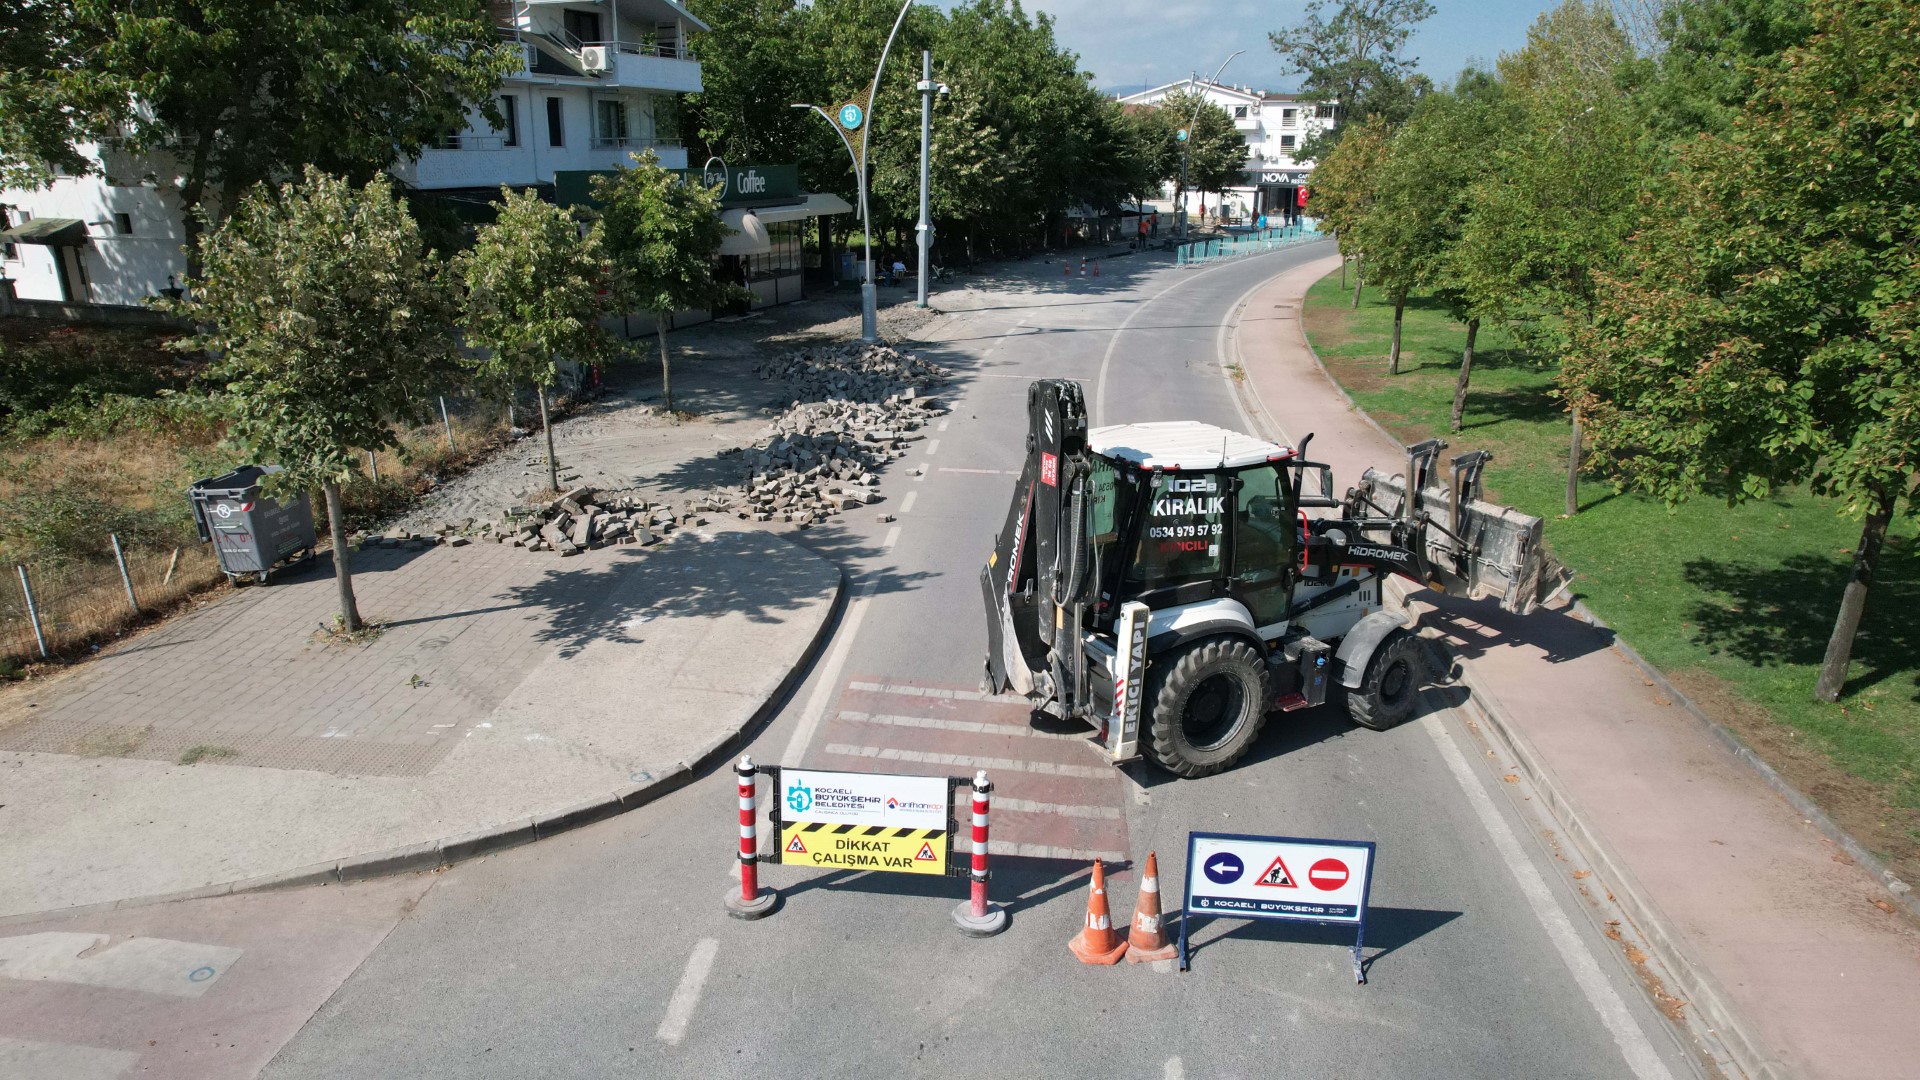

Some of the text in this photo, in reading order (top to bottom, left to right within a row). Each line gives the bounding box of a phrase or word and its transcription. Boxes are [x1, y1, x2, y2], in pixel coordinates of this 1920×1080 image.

[737, 170, 765, 194] Coffee
[1262, 173, 1289, 182] NOVA
[1153, 494, 1224, 516] KİRALIK
[1150, 524, 1223, 538] 0534 979 57 92
[1007, 510, 1024, 582] ROMEK
[1348, 546, 1408, 562] HİDROMEK
[1130, 621, 1146, 673] YAPI
[815, 794, 881, 803] BÜYÜKŞEHİR
[835, 837, 890, 852] DİKKAT
[812, 852, 913, 868] ÇALIŞMA VAR
[1214, 900, 1256, 909] KOCAELİ
